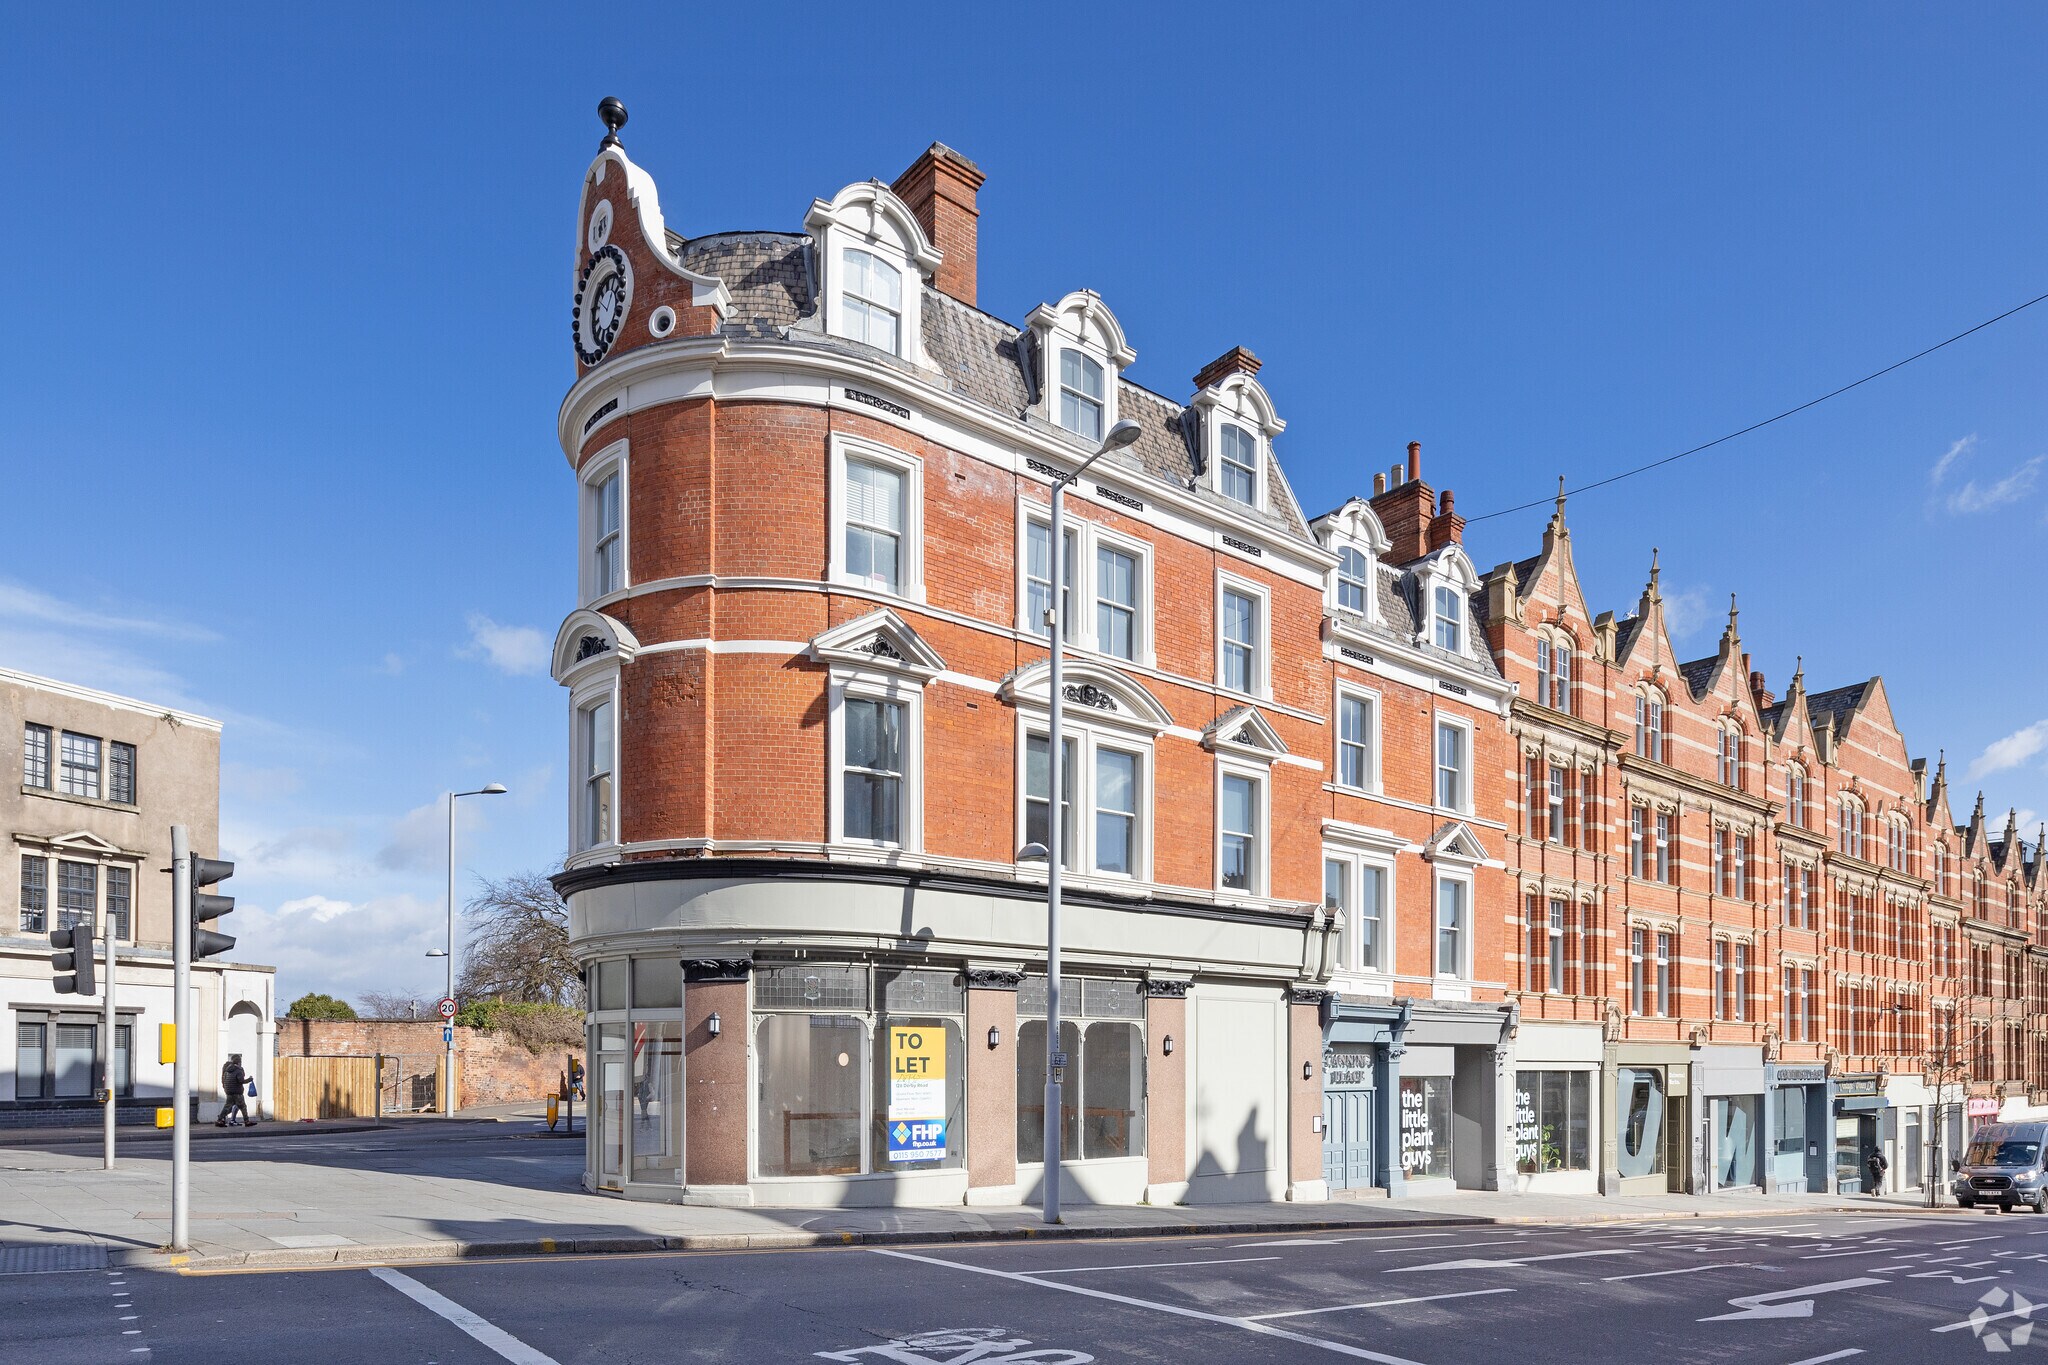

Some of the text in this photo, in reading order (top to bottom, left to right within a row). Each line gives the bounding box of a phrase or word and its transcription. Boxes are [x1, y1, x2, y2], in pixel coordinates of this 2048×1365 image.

[441, 1004, 455, 1013] 20
[895, 1033, 923, 1050] TO
[895, 1057, 930, 1073] LET
[1402, 1089, 1423, 1108] the
[1402, 1108, 1429, 1128] little
[1515, 1106, 1535, 1124] ittle
[912, 1124, 943, 1140] FHP
[1402, 1127, 1434, 1152] plant
[912, 1140, 937, 1148] fhp.co.uk
[1515, 1142, 1537, 1162] guys
[893, 1152, 909, 1160] 0115
[910, 1151, 924, 1159] 950
[1402, 1150, 1432, 1171] guys
